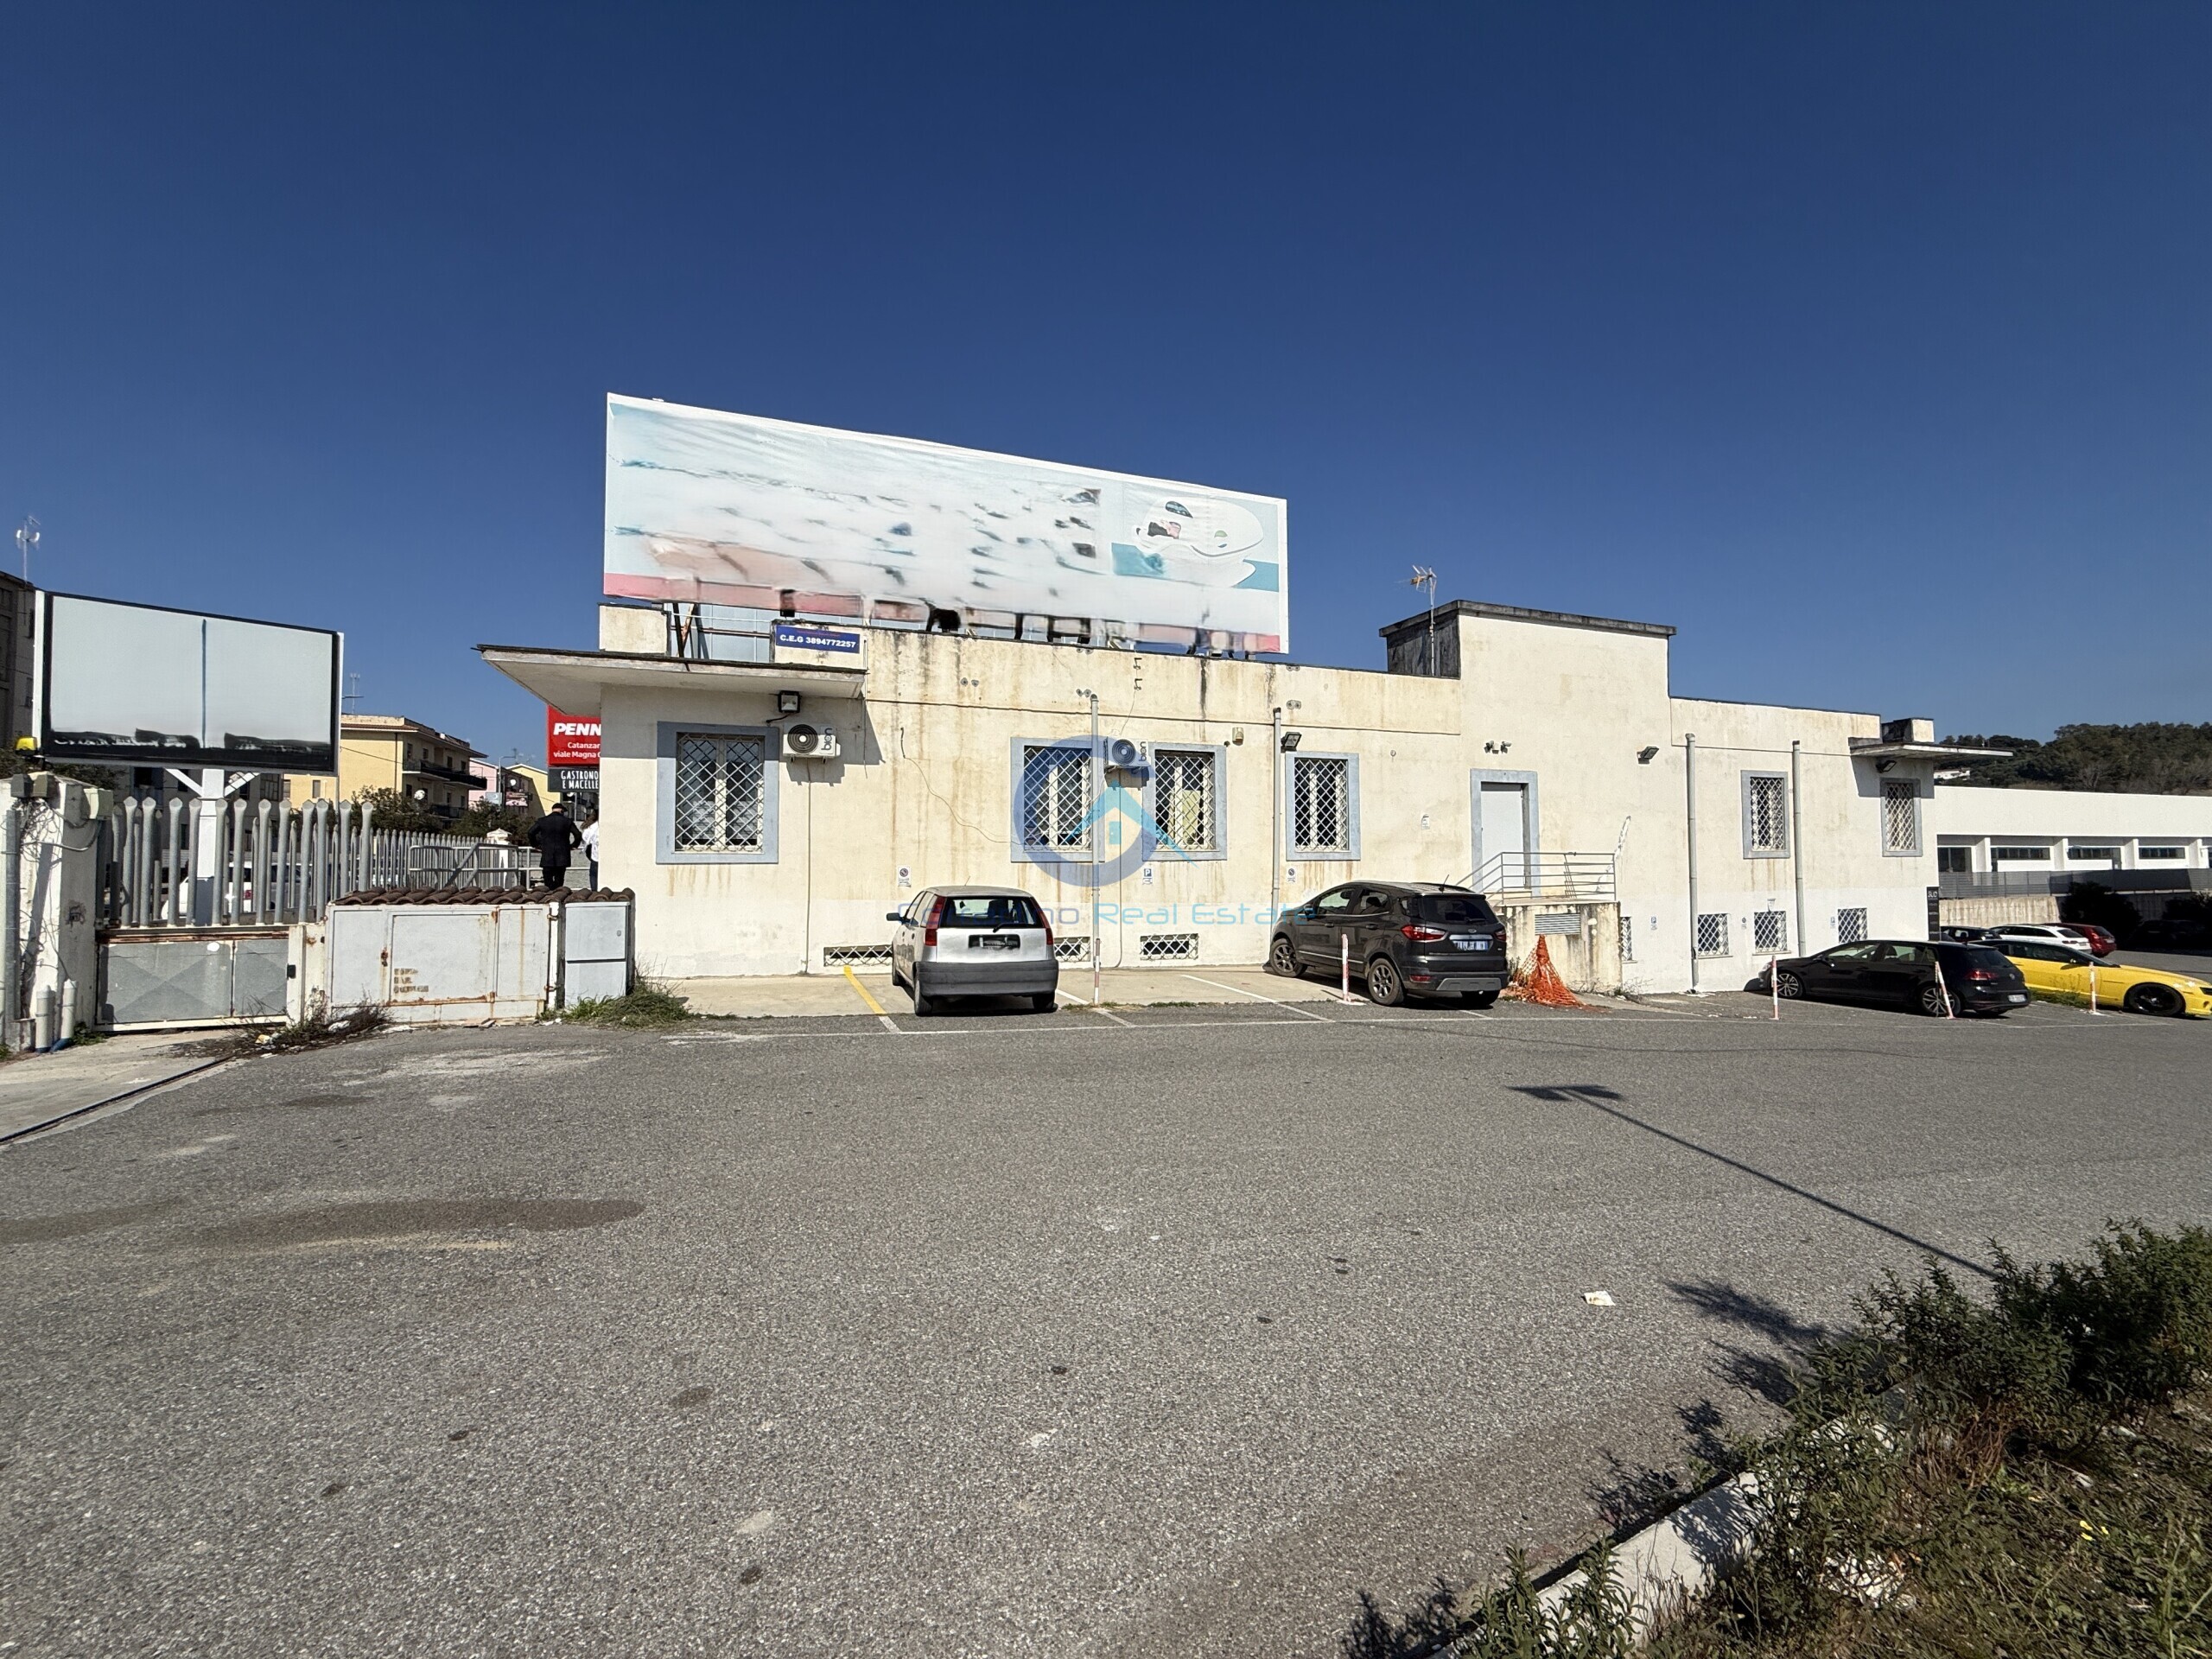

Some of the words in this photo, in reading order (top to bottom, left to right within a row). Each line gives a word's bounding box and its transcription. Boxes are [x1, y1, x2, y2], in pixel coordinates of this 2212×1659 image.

[779, 634, 804, 643] C.E.G
[805, 636, 856, 648] 3894772257
[553, 722, 601, 736] PENN
[571, 751, 596, 760] Magna
[561, 770, 599, 779] GASTRONO
[562, 779, 567, 789] E
[569, 779, 599, 789] MACELLE
